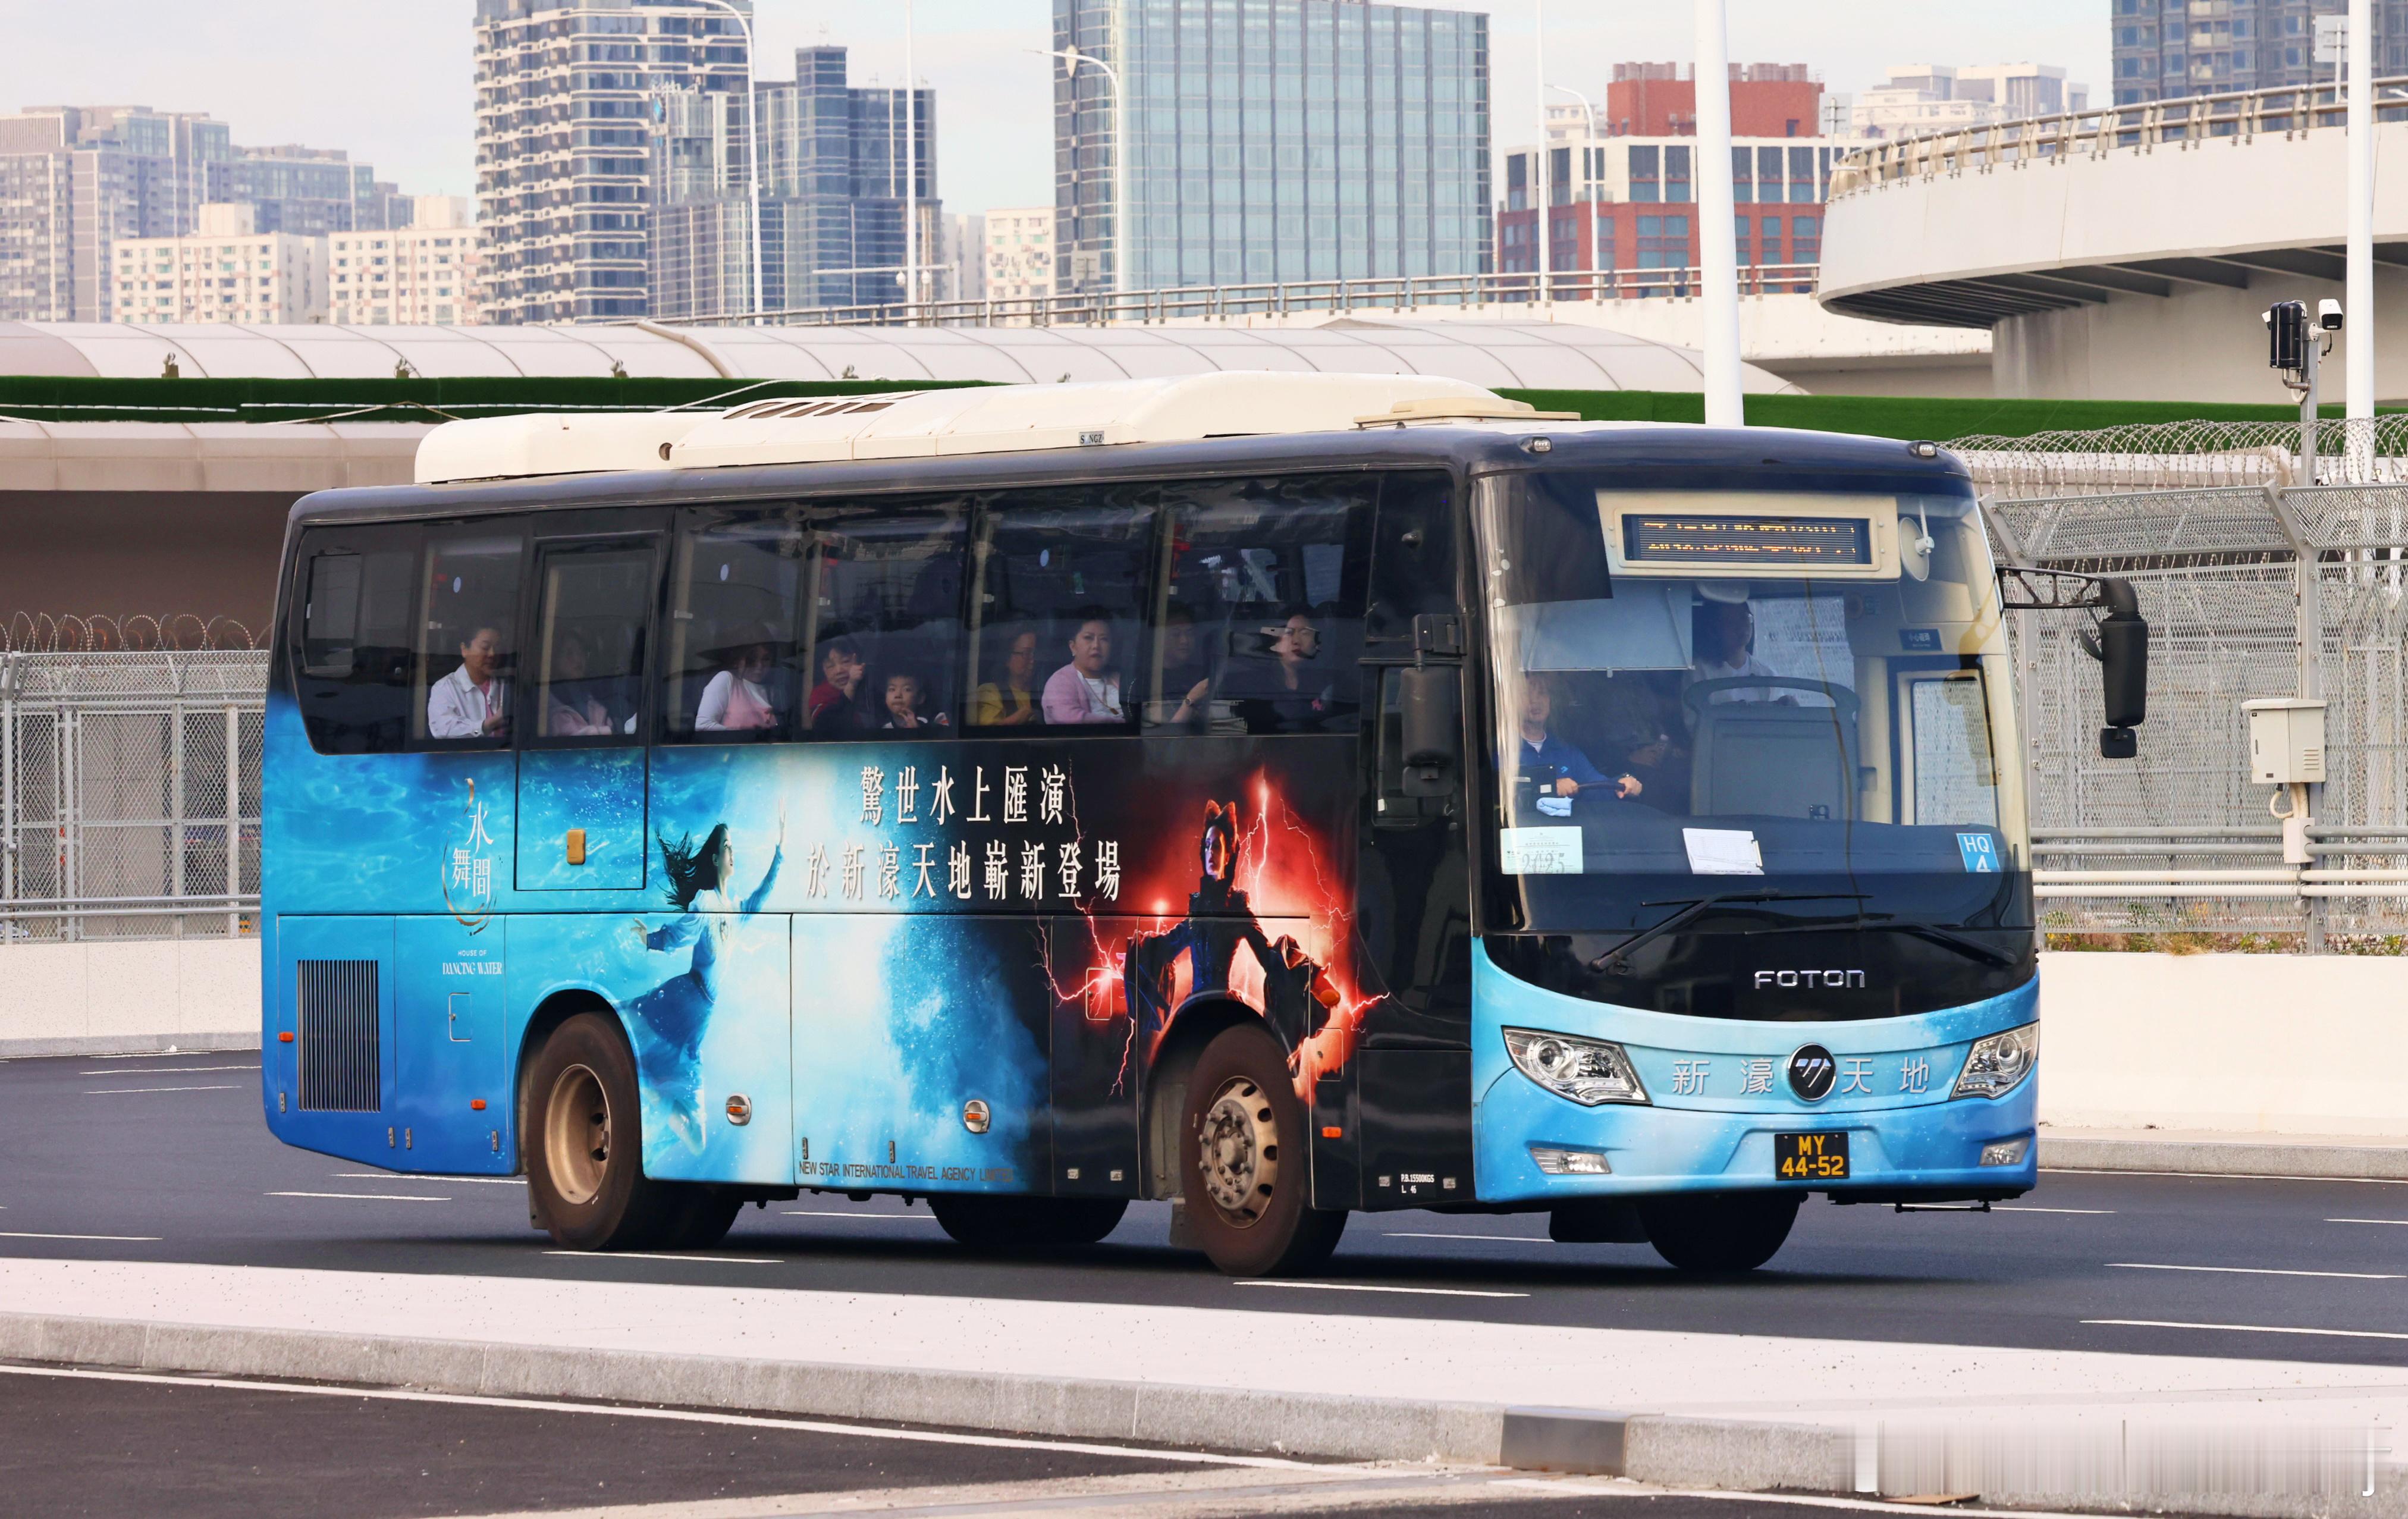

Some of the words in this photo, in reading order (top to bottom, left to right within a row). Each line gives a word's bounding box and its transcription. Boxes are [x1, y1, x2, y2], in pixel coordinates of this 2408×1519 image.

[1080, 434, 1103, 444] SNGZ
[860, 764, 1066, 826] 驚世水上匯演
[1963, 836, 1990, 853] HQ
[806, 839, 1121, 902] 於新濠天地嶄新登場
[442, 962, 476, 975] DANCING
[477, 962, 502, 975] WATER
[1754, 969, 1866, 990] FOTON
[1672, 1057, 1929, 1095] 新濠天地
[1798, 1135, 1826, 1156] MY
[799, 1161, 817, 1175] NEW
[819, 1162, 840, 1176] STAR
[843, 1163, 905, 1179] INTERNATIONAL
[906, 1166, 938, 1180] TRAVEL
[941, 1167, 976, 1181] AGENCY
[1781, 1156, 1844, 1178] 44-52
[1401, 1184, 1407, 1194] L
